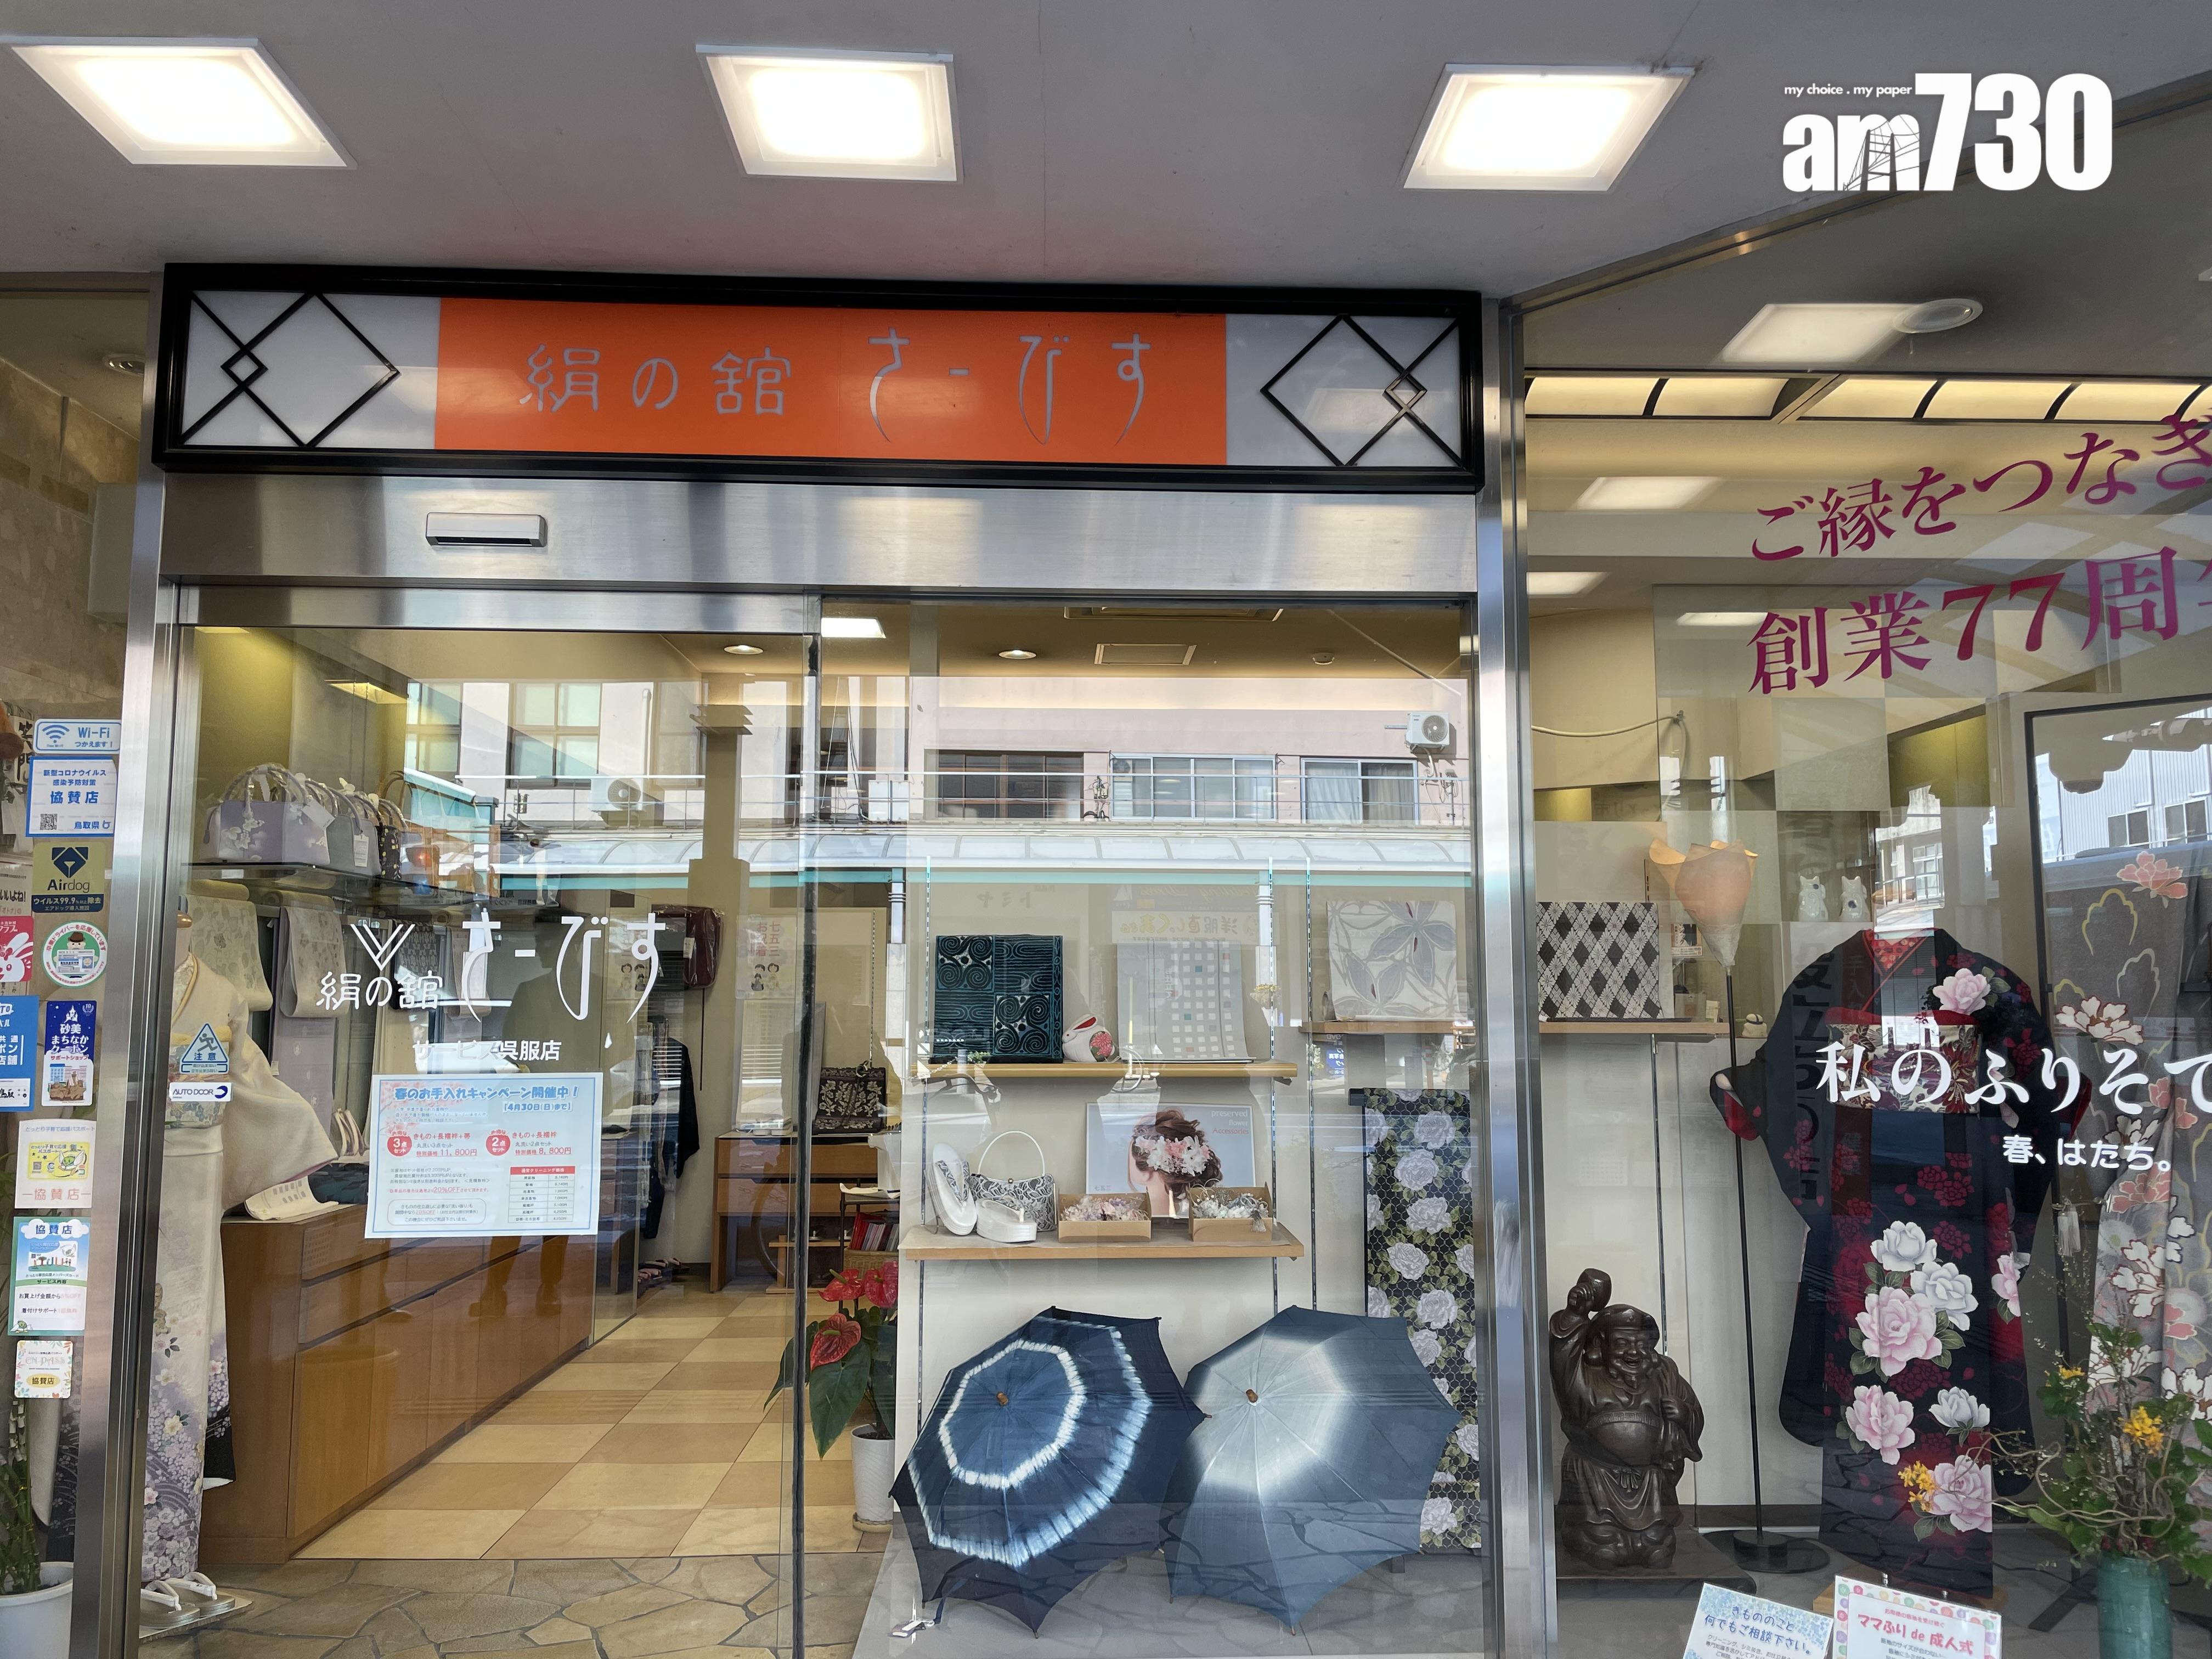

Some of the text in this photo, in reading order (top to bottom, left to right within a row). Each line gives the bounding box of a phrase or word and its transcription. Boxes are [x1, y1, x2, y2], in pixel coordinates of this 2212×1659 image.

[520, 345, 792, 416] 絹の館
[1747, 545, 2212, 695] 創業77周
[78, 727, 110, 738] Wi-Fi
[50, 791, 99, 804] 協賛店
[47, 879, 90, 893] Airdog
[315, 970, 443, 1011] 絹の館
[60, 1023, 82, 1034] 砂美
[51, 1035, 89, 1045] まちなか
[51, 1044, 88, 1054] クーポン
[413, 1040, 562, 1061] サービス呉服店
[194, 1052, 216, 1061] 注意
[395, 1086, 579, 1100] 春のお手入れキャンペーン開催中！
[1211, 1109, 1249, 1118] preserved
[393, 1138, 407, 1148] 3点
[492, 1137, 506, 1147] 2点
[2002, 1135, 2171, 1173] 春、はたち。
[35, 1188, 80, 1200] 協賛店
[36, 1224, 72, 1234] 協賛店
[1705, 1615, 1810, 1655] 何でもご相談下さい。
[1858, 1614, 1974, 1655] ママふり de 成人式
